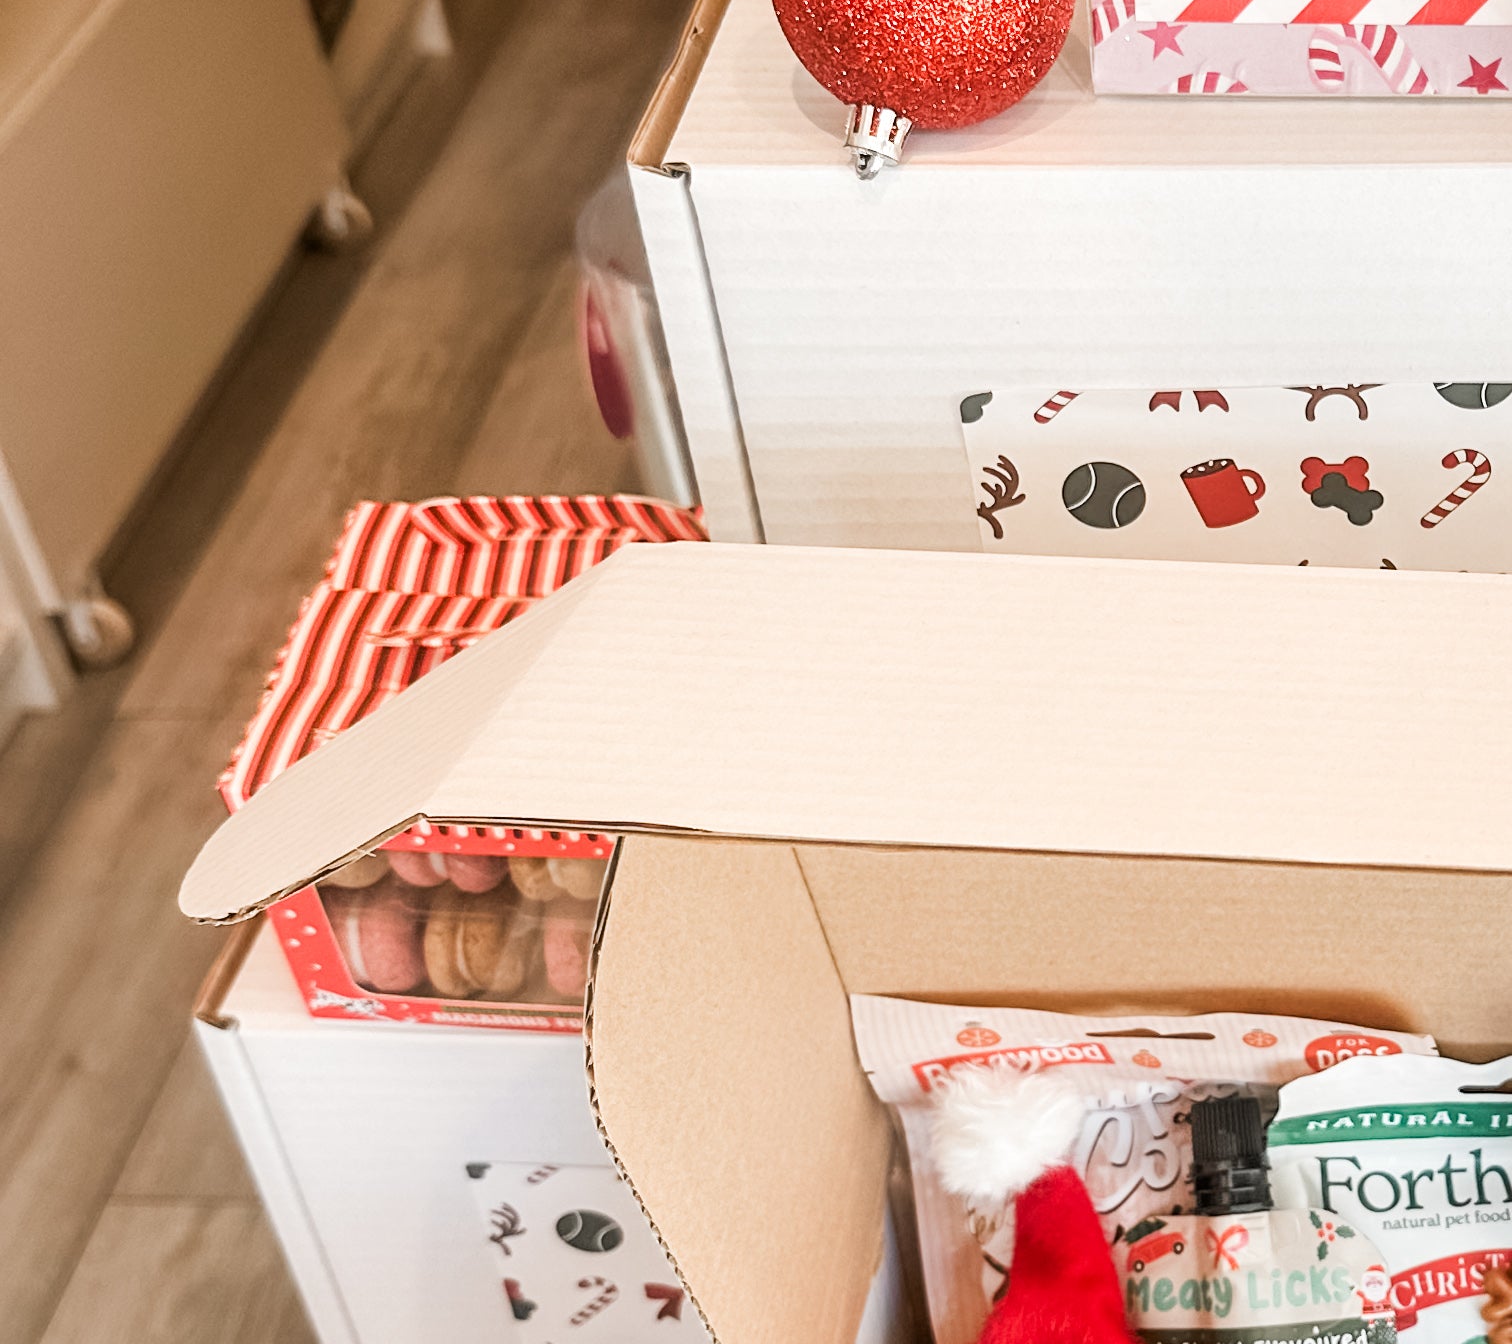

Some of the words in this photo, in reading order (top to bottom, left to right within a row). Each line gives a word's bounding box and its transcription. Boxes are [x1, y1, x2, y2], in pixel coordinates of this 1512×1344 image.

[555, 1017, 583, 1029] FO
[1335, 1038, 1370, 1047] FOR
[1307, 1110, 1474, 1131] NATURAL
[1382, 1212, 1442, 1232] natural
[1445, 1211, 1470, 1230] pet
[1474, 1207, 1512, 1225] food
[1126, 1270, 1233, 1319] Meaty
